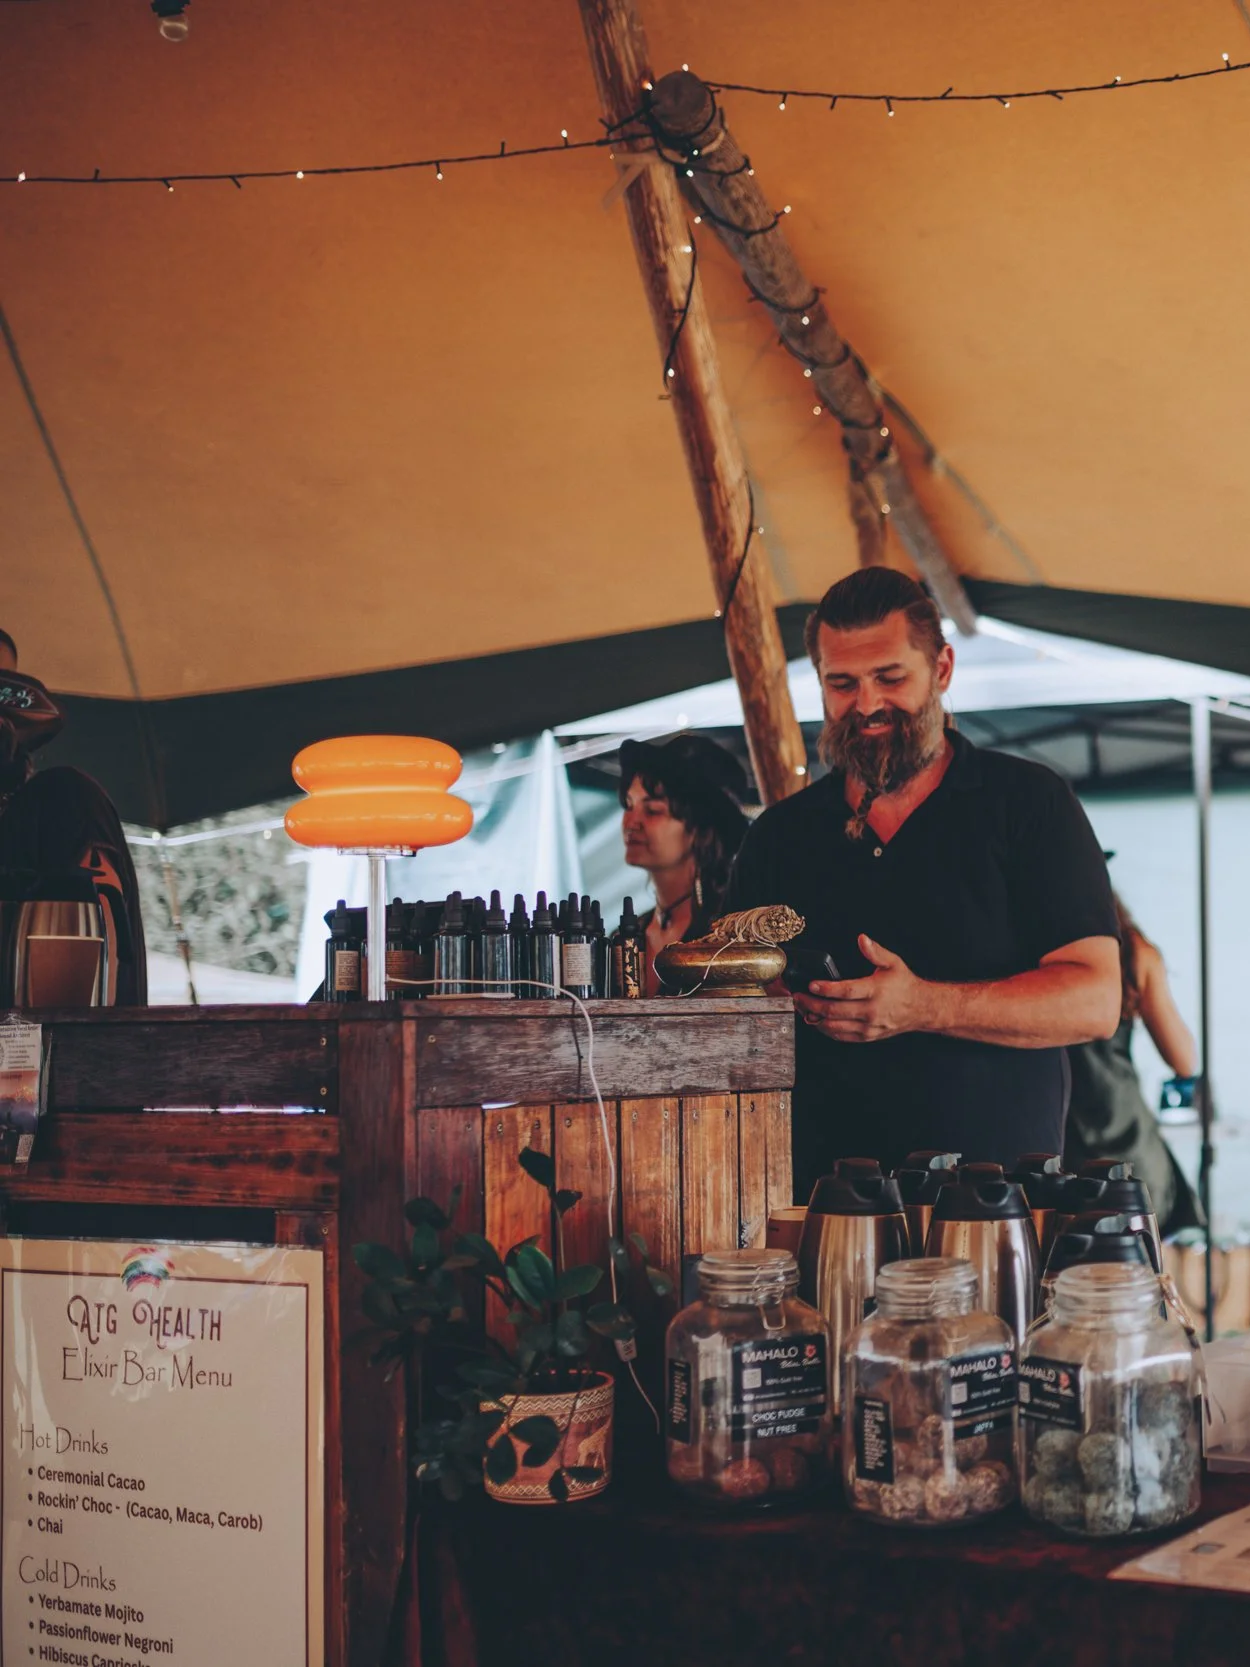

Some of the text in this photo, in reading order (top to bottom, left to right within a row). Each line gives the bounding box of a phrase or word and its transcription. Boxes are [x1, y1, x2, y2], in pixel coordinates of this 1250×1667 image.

[133, 1299, 222, 1349] HEALTH
[62, 1347, 232, 1389] Elixir Bar Menu
[742, 1346, 799, 1363] MAHALO
[20, 1423, 108, 1454] Hot Drinks
[775, 1424, 797, 1434] FREE
[37, 1465, 146, 1491] Ceremonial Cacao
[37, 1517, 63, 1534] Chai
[81, 1497, 113, 1514] Choc
[126, 1501, 173, 1524] (Cacao,
[176, 1506, 215, 1528] Maca,
[217, 1511, 263, 1532] Carob)
[19, 1555, 116, 1592] Cold Drinks
[38, 1593, 144, 1625] Yerbamate Mojito
[38, 1619, 174, 1654] Passionflower Negroni
[38, 1645, 89, 1667] Hibiscus
